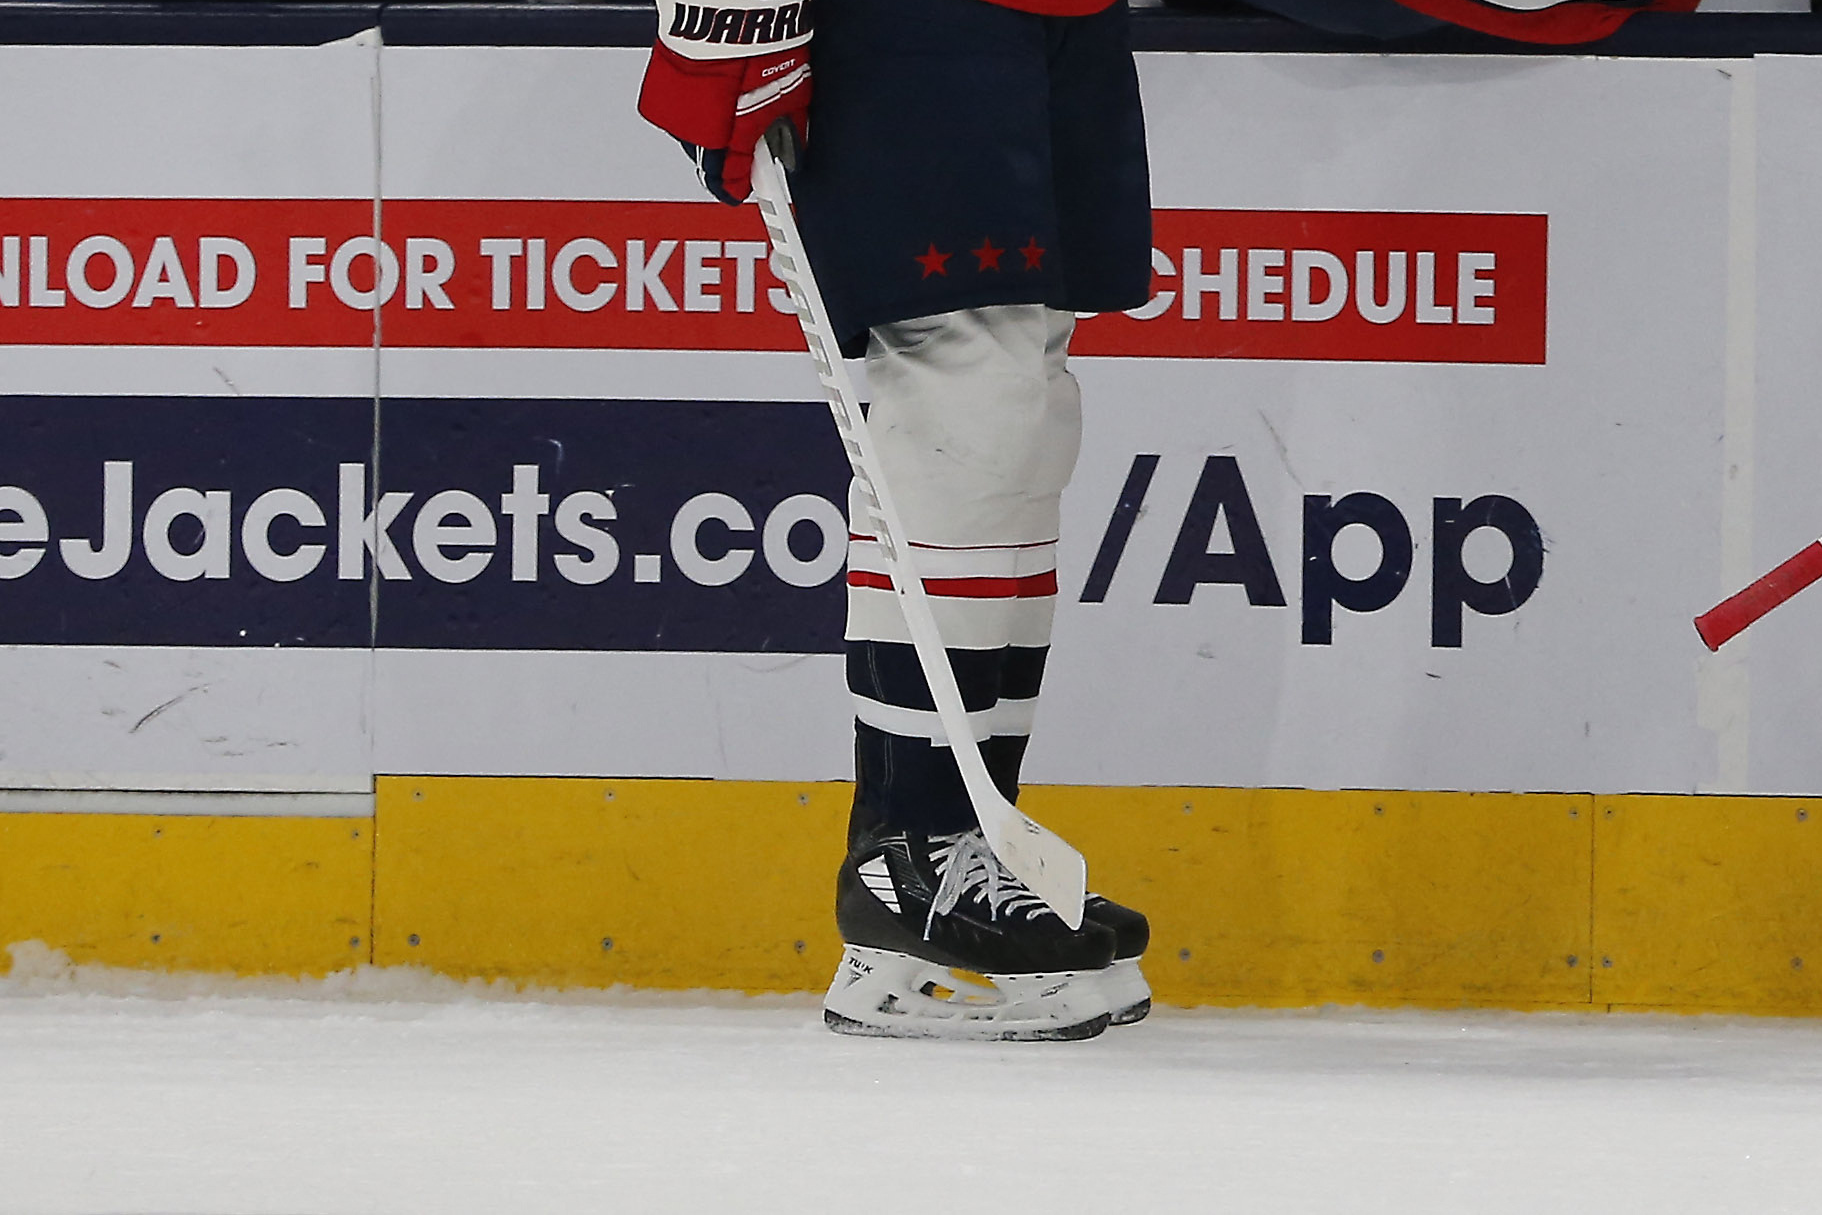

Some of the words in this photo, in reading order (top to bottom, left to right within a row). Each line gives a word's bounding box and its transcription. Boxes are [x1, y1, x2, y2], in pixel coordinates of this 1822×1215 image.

[761, 58, 796, 78] COVERT
[288, 236, 457, 312] FOR
[480, 237, 803, 316] TICKETS
[1076, 247, 1497, 326] CHEDULE
